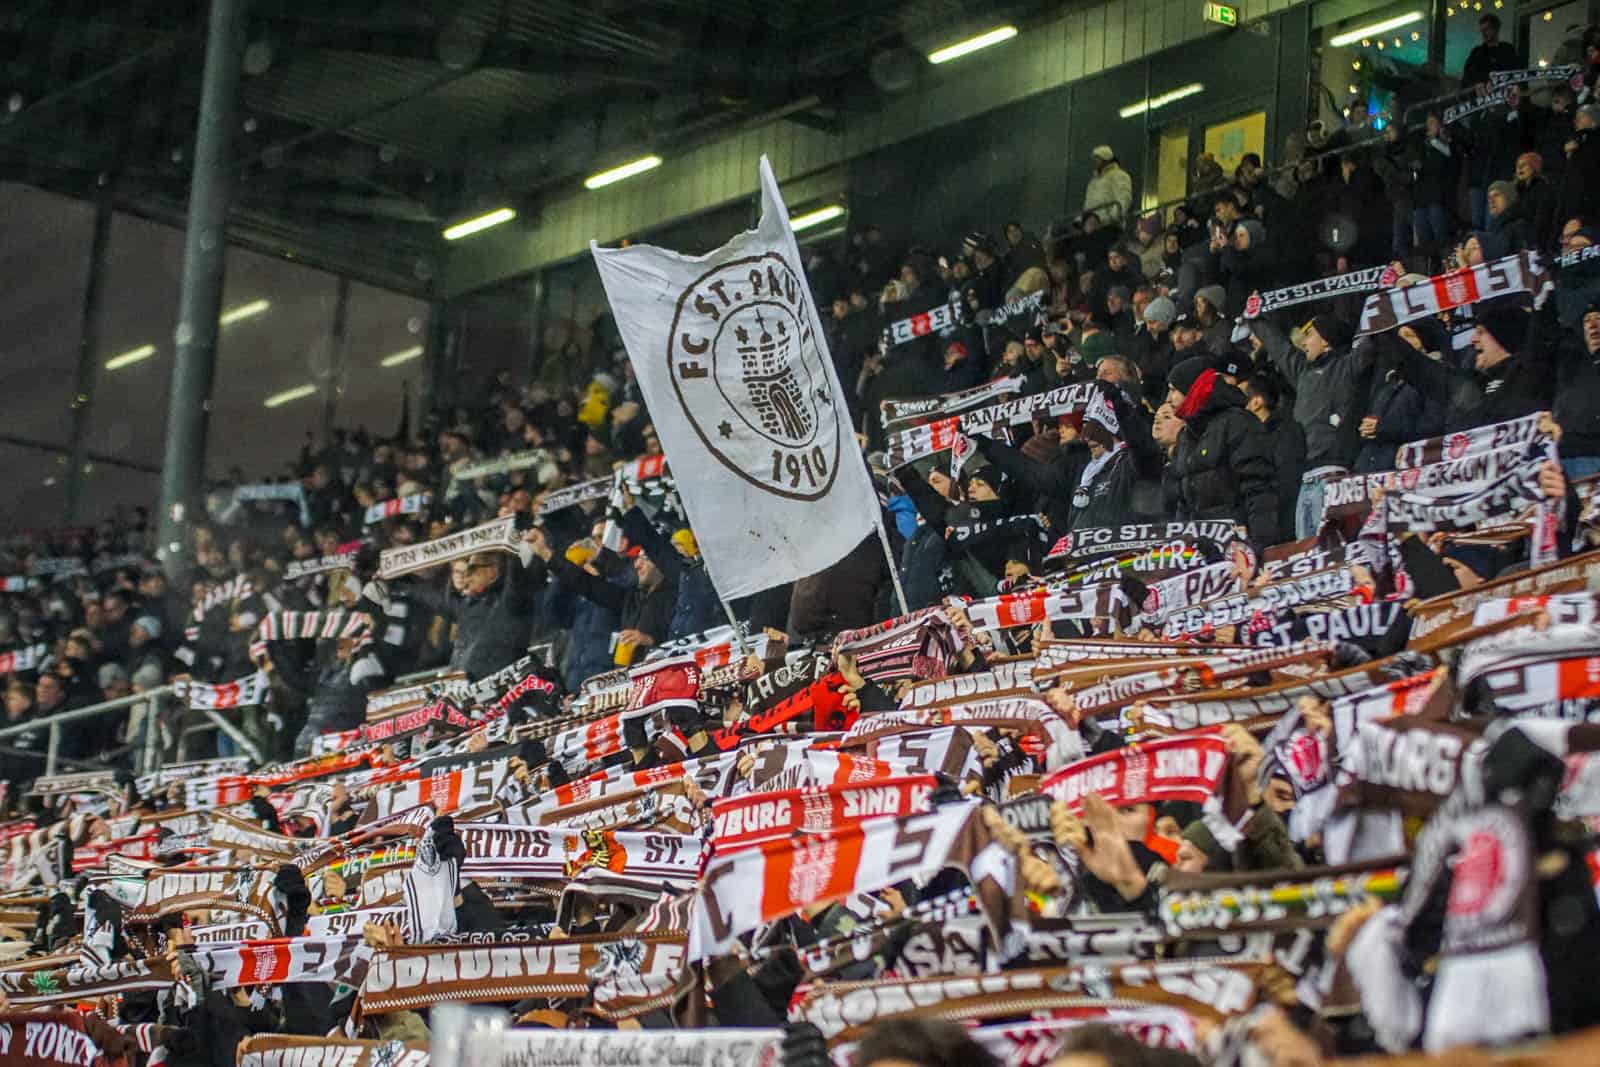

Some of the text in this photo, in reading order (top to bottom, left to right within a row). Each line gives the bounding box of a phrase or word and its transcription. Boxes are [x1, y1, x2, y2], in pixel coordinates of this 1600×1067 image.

[679, 332, 709, 380] FC
[770, 445, 829, 489] 1910
[1077, 525, 1113, 546] FC
[1119, 523, 1156, 541] ST.
[1305, 602, 1400, 641] PAULI
[840, 787, 901, 818] SIND
[644, 834, 685, 865] ST.
